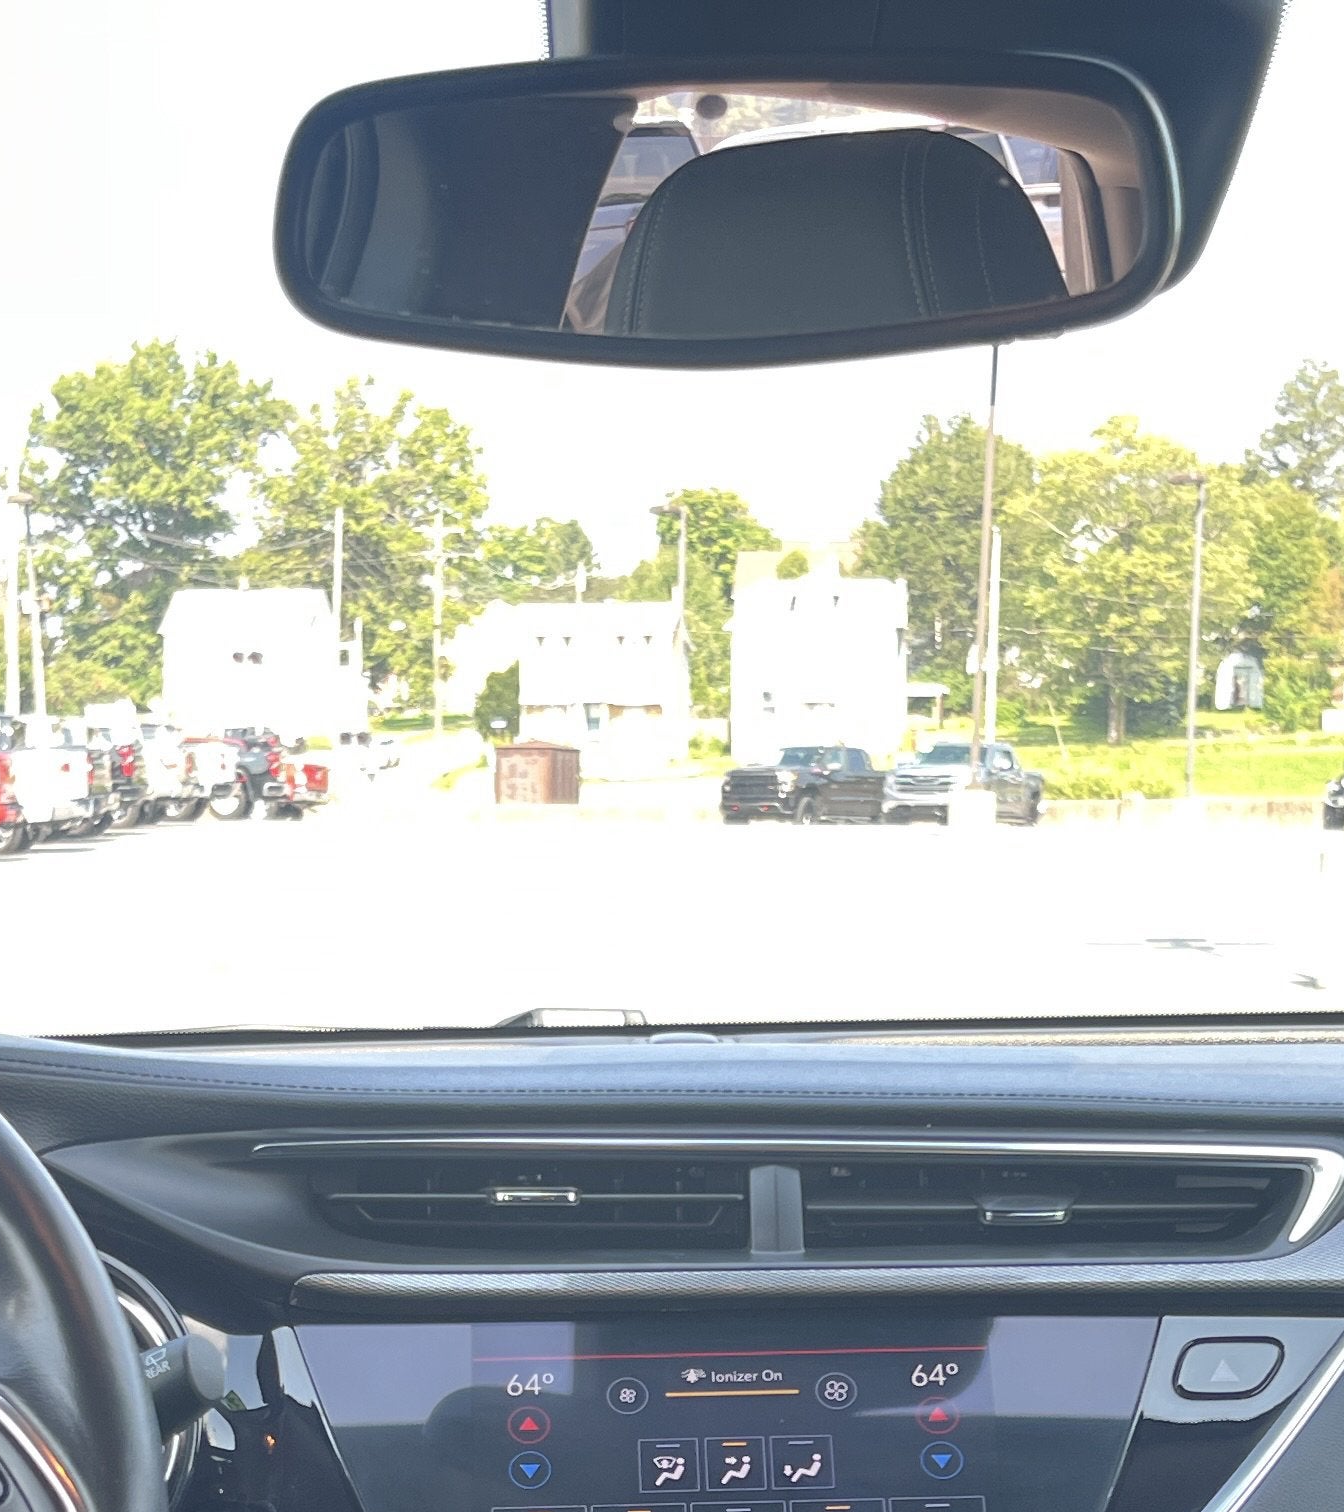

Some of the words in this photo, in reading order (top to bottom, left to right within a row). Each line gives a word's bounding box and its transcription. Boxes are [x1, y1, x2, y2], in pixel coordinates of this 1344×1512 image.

[145, 1360, 171, 1380] REAR
[710, 1370, 758, 1384] Ionizer
[761, 1368, 783, 1382] On
